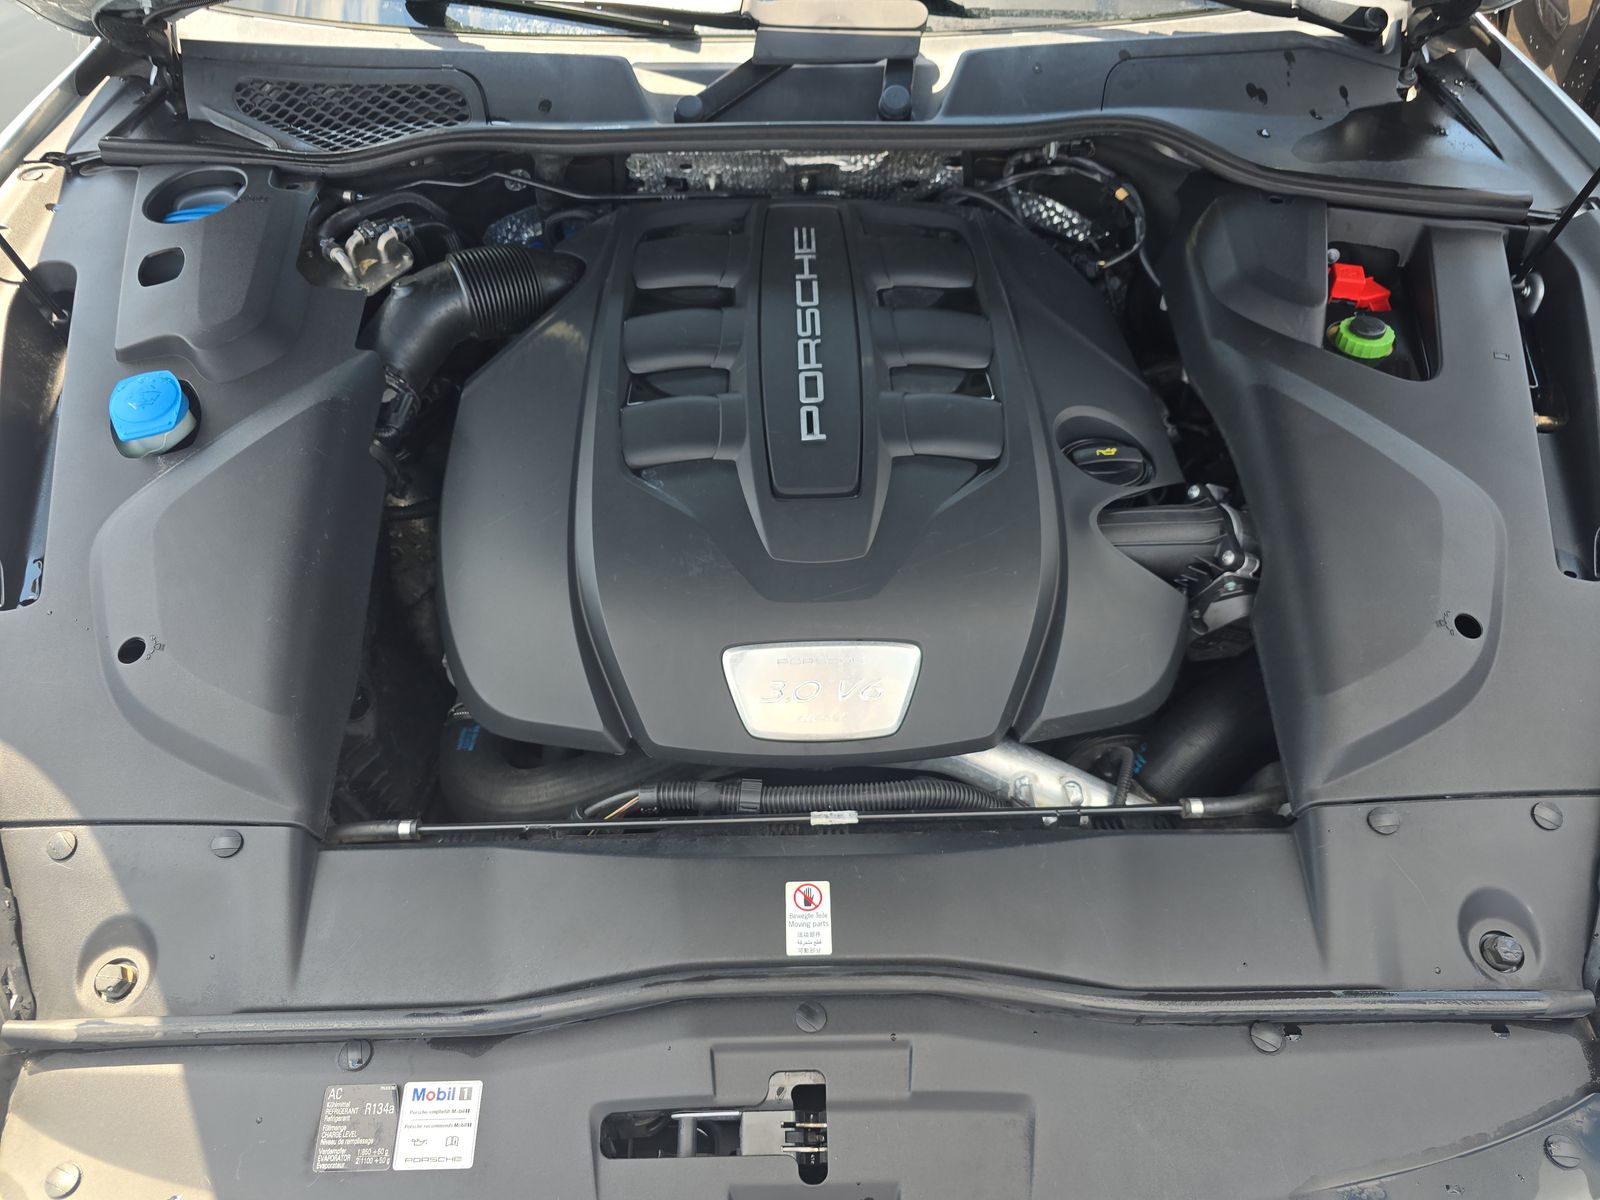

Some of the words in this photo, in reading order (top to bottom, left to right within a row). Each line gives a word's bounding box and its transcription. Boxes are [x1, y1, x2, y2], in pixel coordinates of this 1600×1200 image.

[794, 227, 826, 441] PORSCHE
[761, 680, 822, 703] 3.0
[839, 679, 883, 702] V6
[788, 920, 811, 928] Moving
[812, 920, 829, 928] parts
[328, 1087, 343, 1100] AC
[411, 1087, 456, 1102] Mobil
[459, 1087, 473, 1101] 1
[364, 1102, 395, 1115] R134a
[342, 1130, 358, 1138] LEVEL
[404, 1155, 463, 1163] PORSCHE
